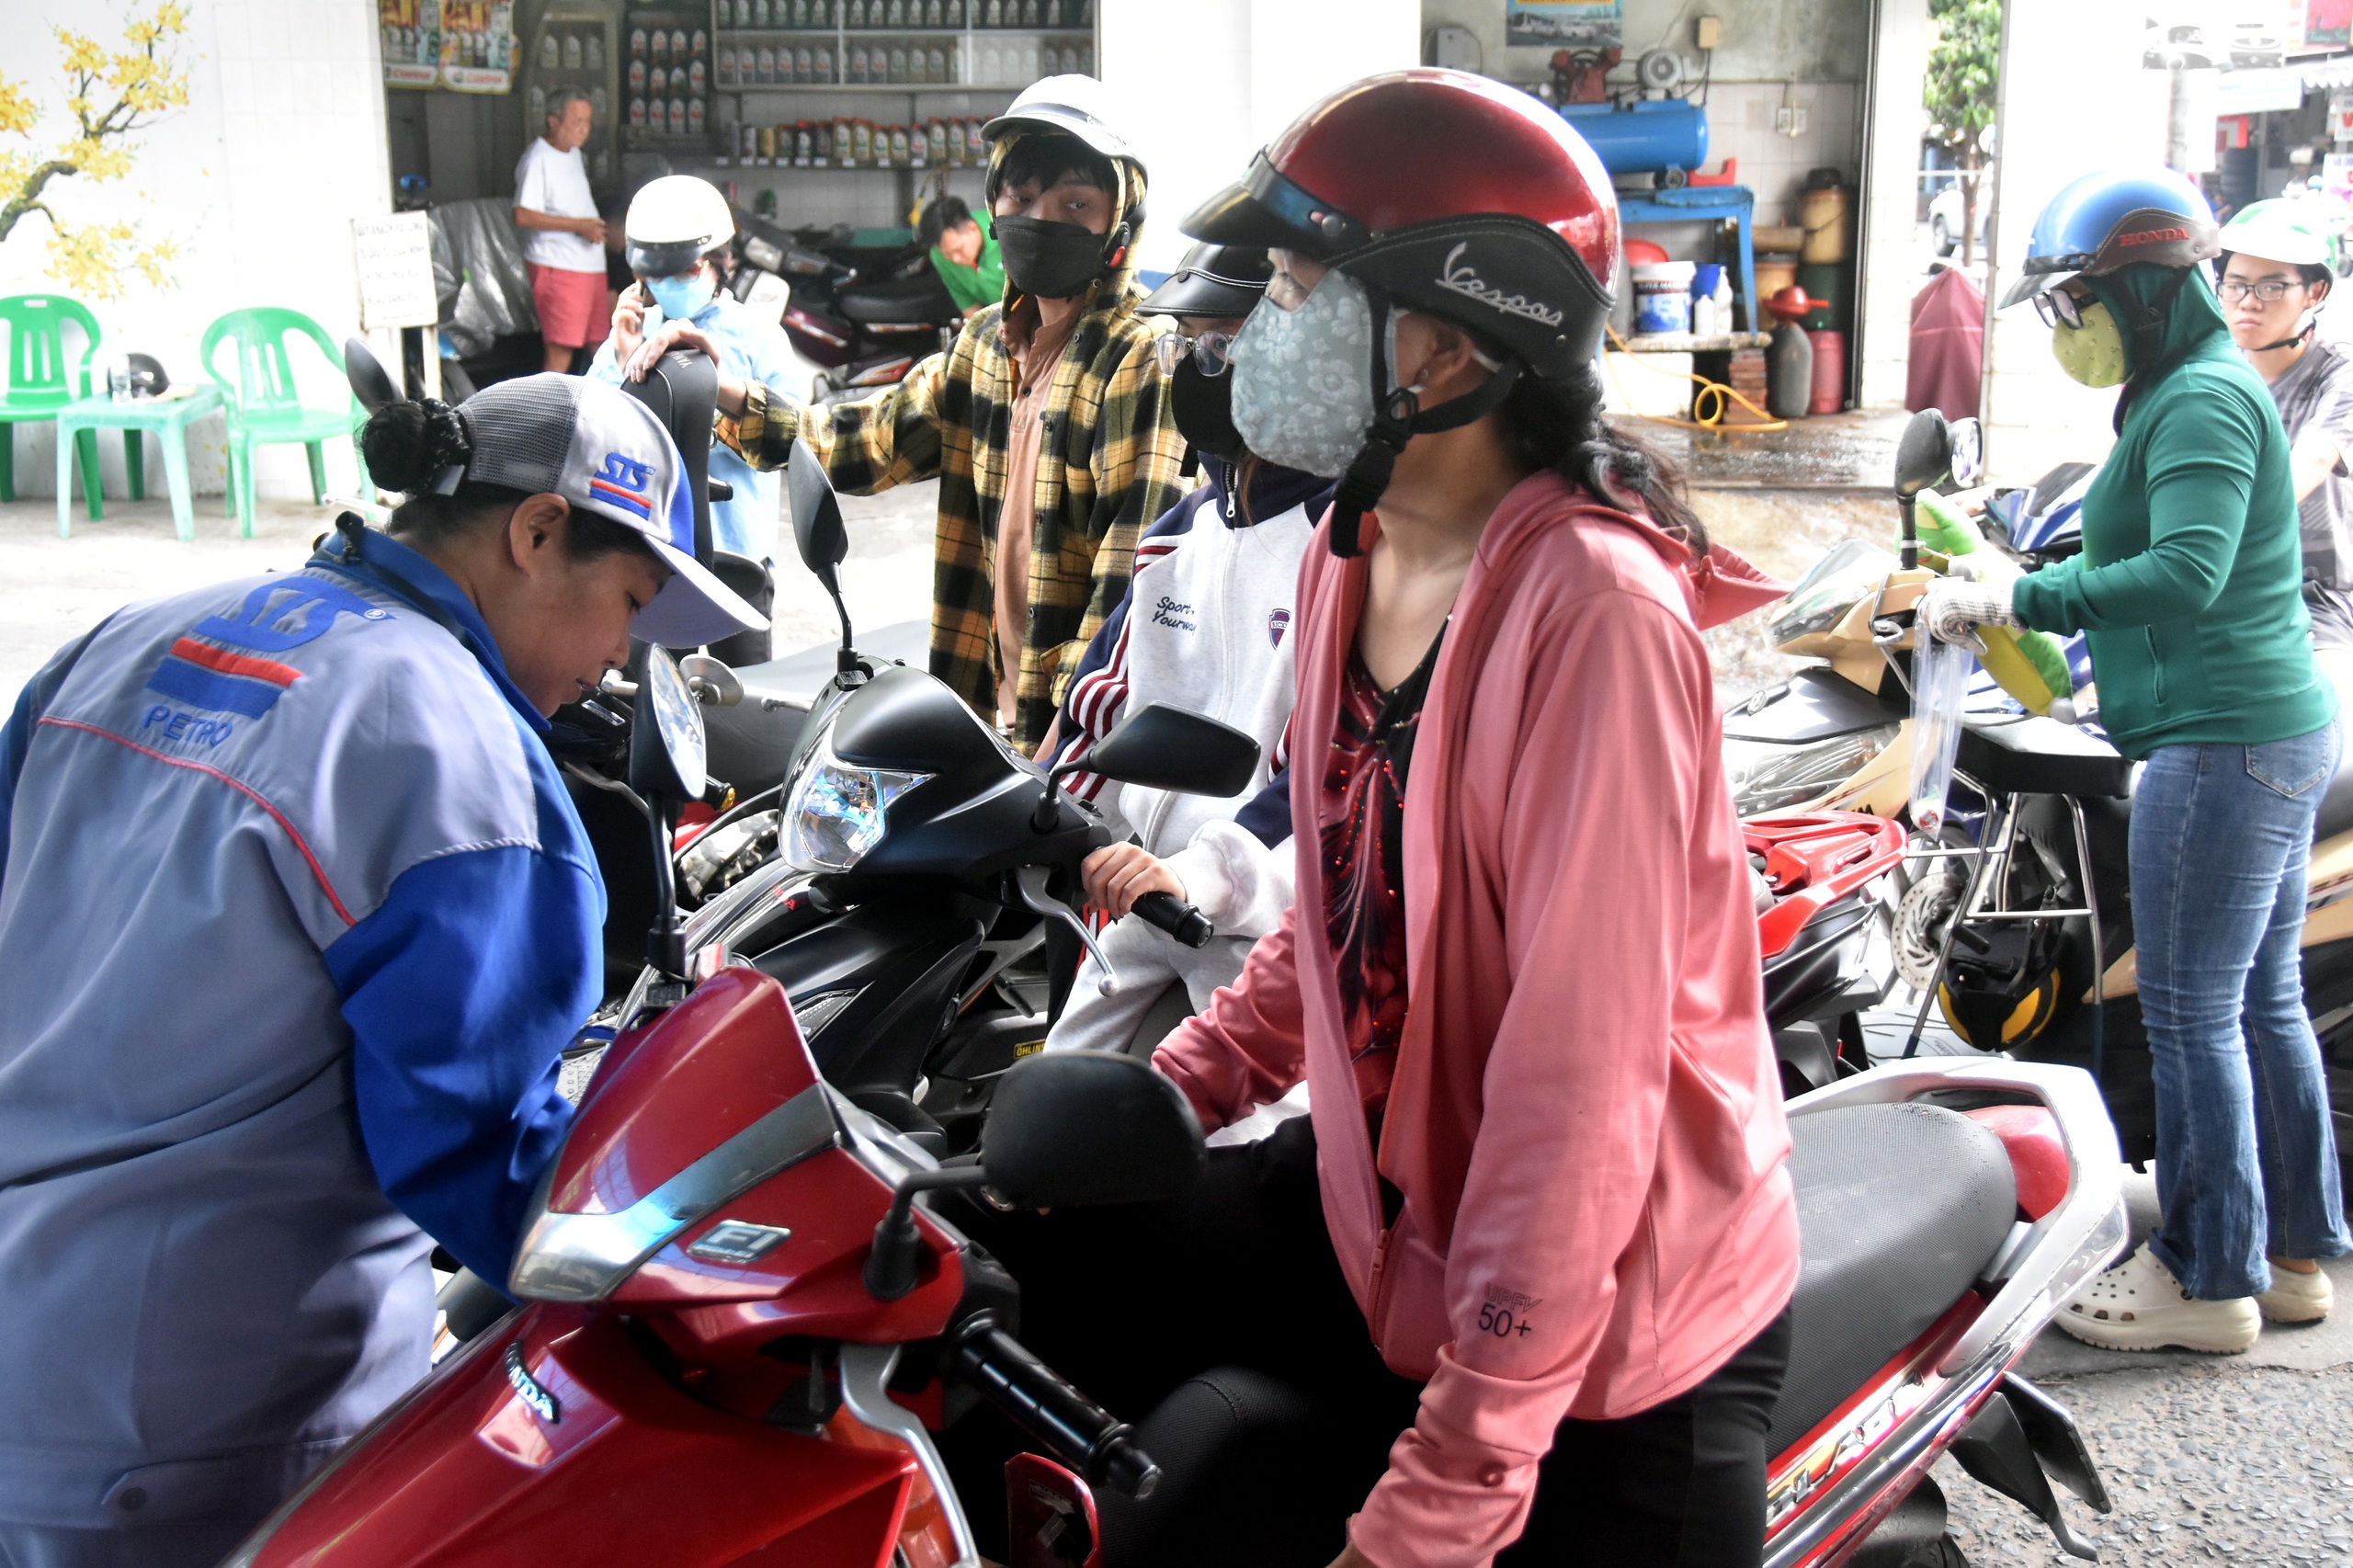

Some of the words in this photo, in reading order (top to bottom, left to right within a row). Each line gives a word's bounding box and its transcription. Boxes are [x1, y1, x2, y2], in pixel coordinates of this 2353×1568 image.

[2119, 228, 2189, 246] HONDA
[1435, 242, 1563, 326] Vespa
[1152, 610, 1198, 636] Yourway
[142, 704, 234, 747] PETRO
[706, 1226, 779, 1250] FI
[1478, 1301, 1532, 1337] 50+
